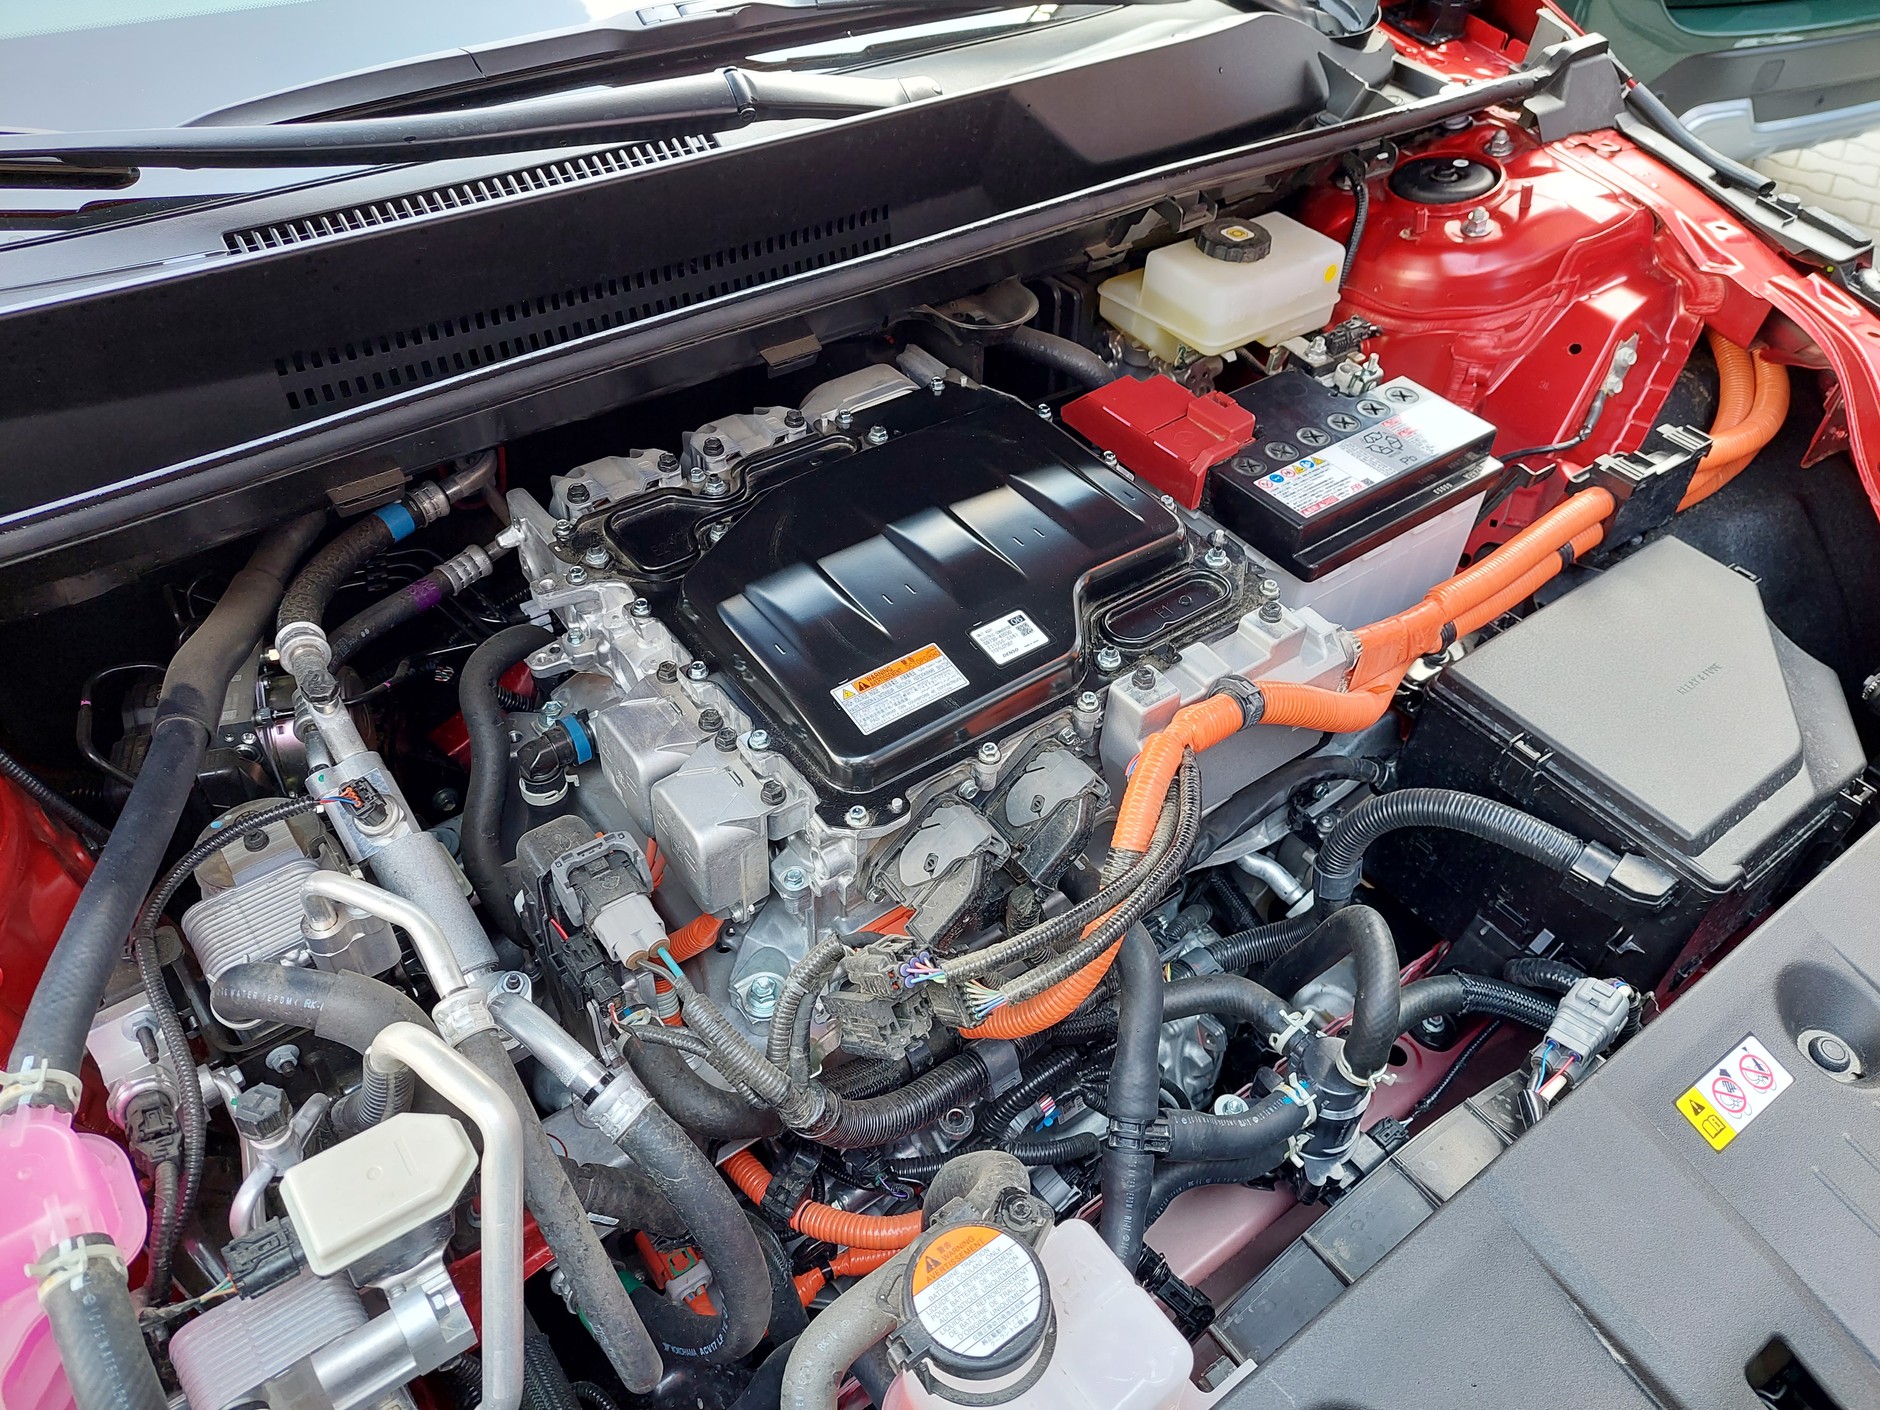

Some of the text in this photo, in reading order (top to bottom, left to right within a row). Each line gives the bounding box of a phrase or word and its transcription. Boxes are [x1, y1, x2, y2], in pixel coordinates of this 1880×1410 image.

[1400, 455, 1418, 465] Pb
[1008, 615, 1023, 625] 06
[864, 666, 892, 682] WARNING
[1001, 647, 1019, 658] DENSO
[230, 989, 258, 1000] WATER
[924, 1237, 985, 1283] AVERTISSEMENT
[932, 1246, 990, 1290] GENUINE TRACTION
[940, 1234, 975, 1261] WARNING
[925, 1248, 1015, 1316] LIQUIDE DE REFROIDISSEMENT
[928, 1246, 1002, 1302] BATTERY COOLANT ONLY
[930, 1254, 1019, 1321] POUR BATTERIE DE TRACTION
[938, 1262, 1019, 1324] AUTHENTIQUE UNIQUEMENT
[939, 1267, 1029, 1335] LIQUIDE DE REFROIDISSEMENT
[948, 1275, 1029, 1338] DE BATTERIE DE TRACTION
[957, 1285, 1029, 1340] D'ORIGINE UNIQUEMENT
